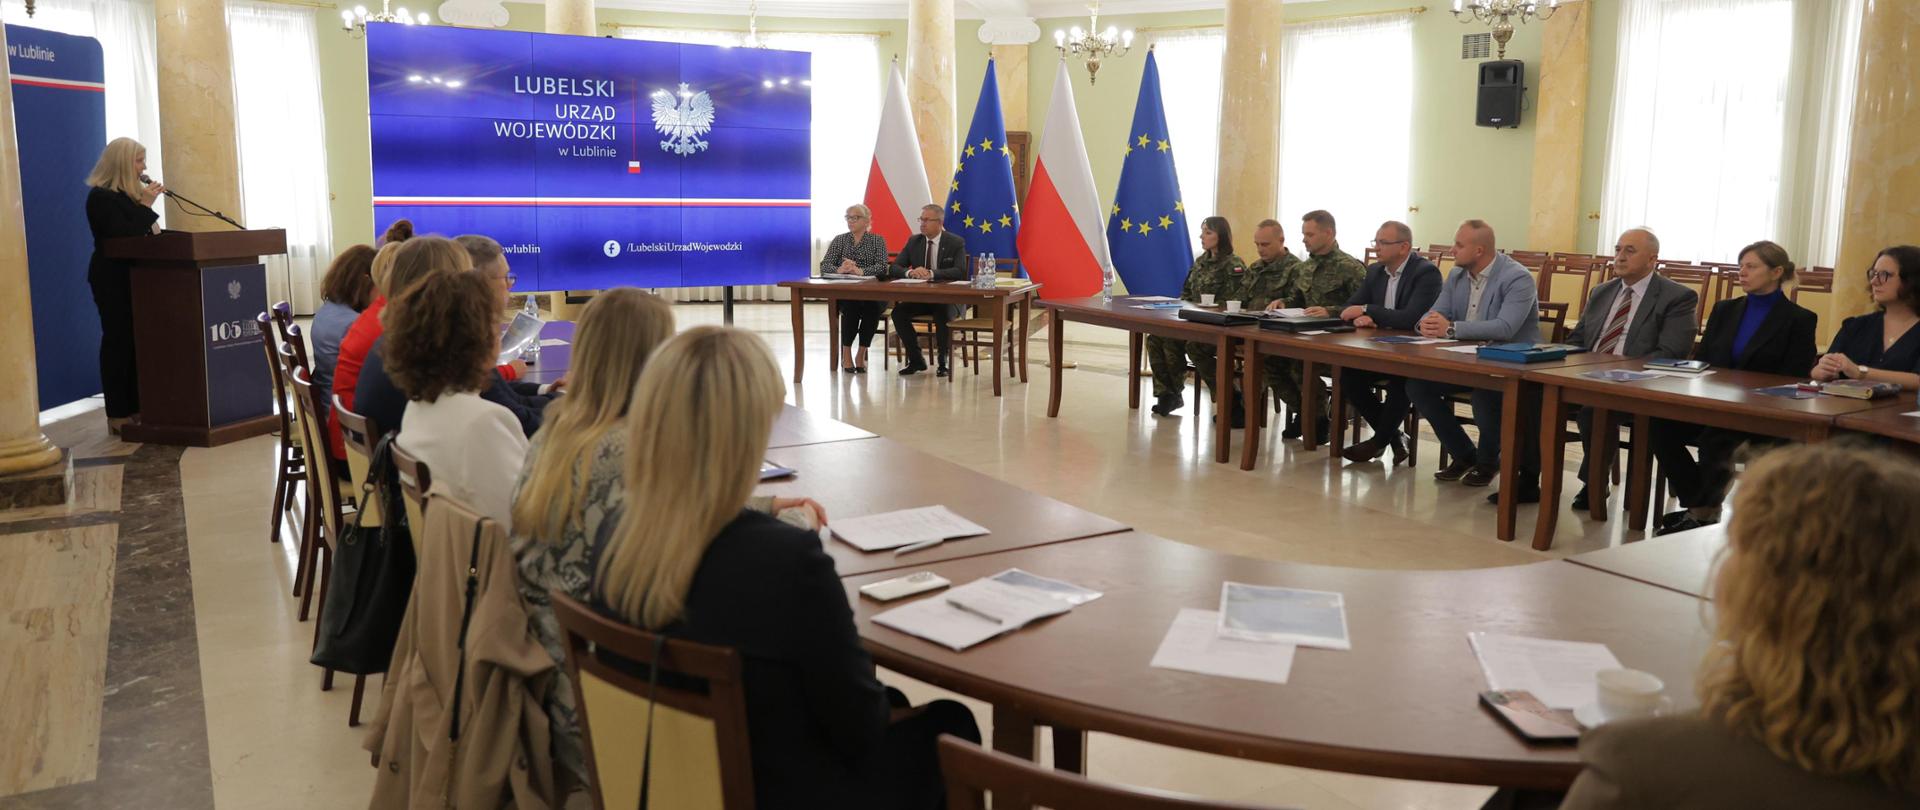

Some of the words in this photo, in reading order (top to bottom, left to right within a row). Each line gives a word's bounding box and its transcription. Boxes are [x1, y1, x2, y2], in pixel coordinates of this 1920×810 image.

[8, 44, 17, 57] w
[18, 44, 55, 62] Lublinie
[514, 75, 615, 98] LUBELSKI
[555, 104, 616, 122] URZĄD
[494, 121, 616, 140] WOJEWÓDZKI
[558, 147, 570, 157] w
[572, 145, 617, 158] Lublinie
[210, 320, 242, 341] 105
